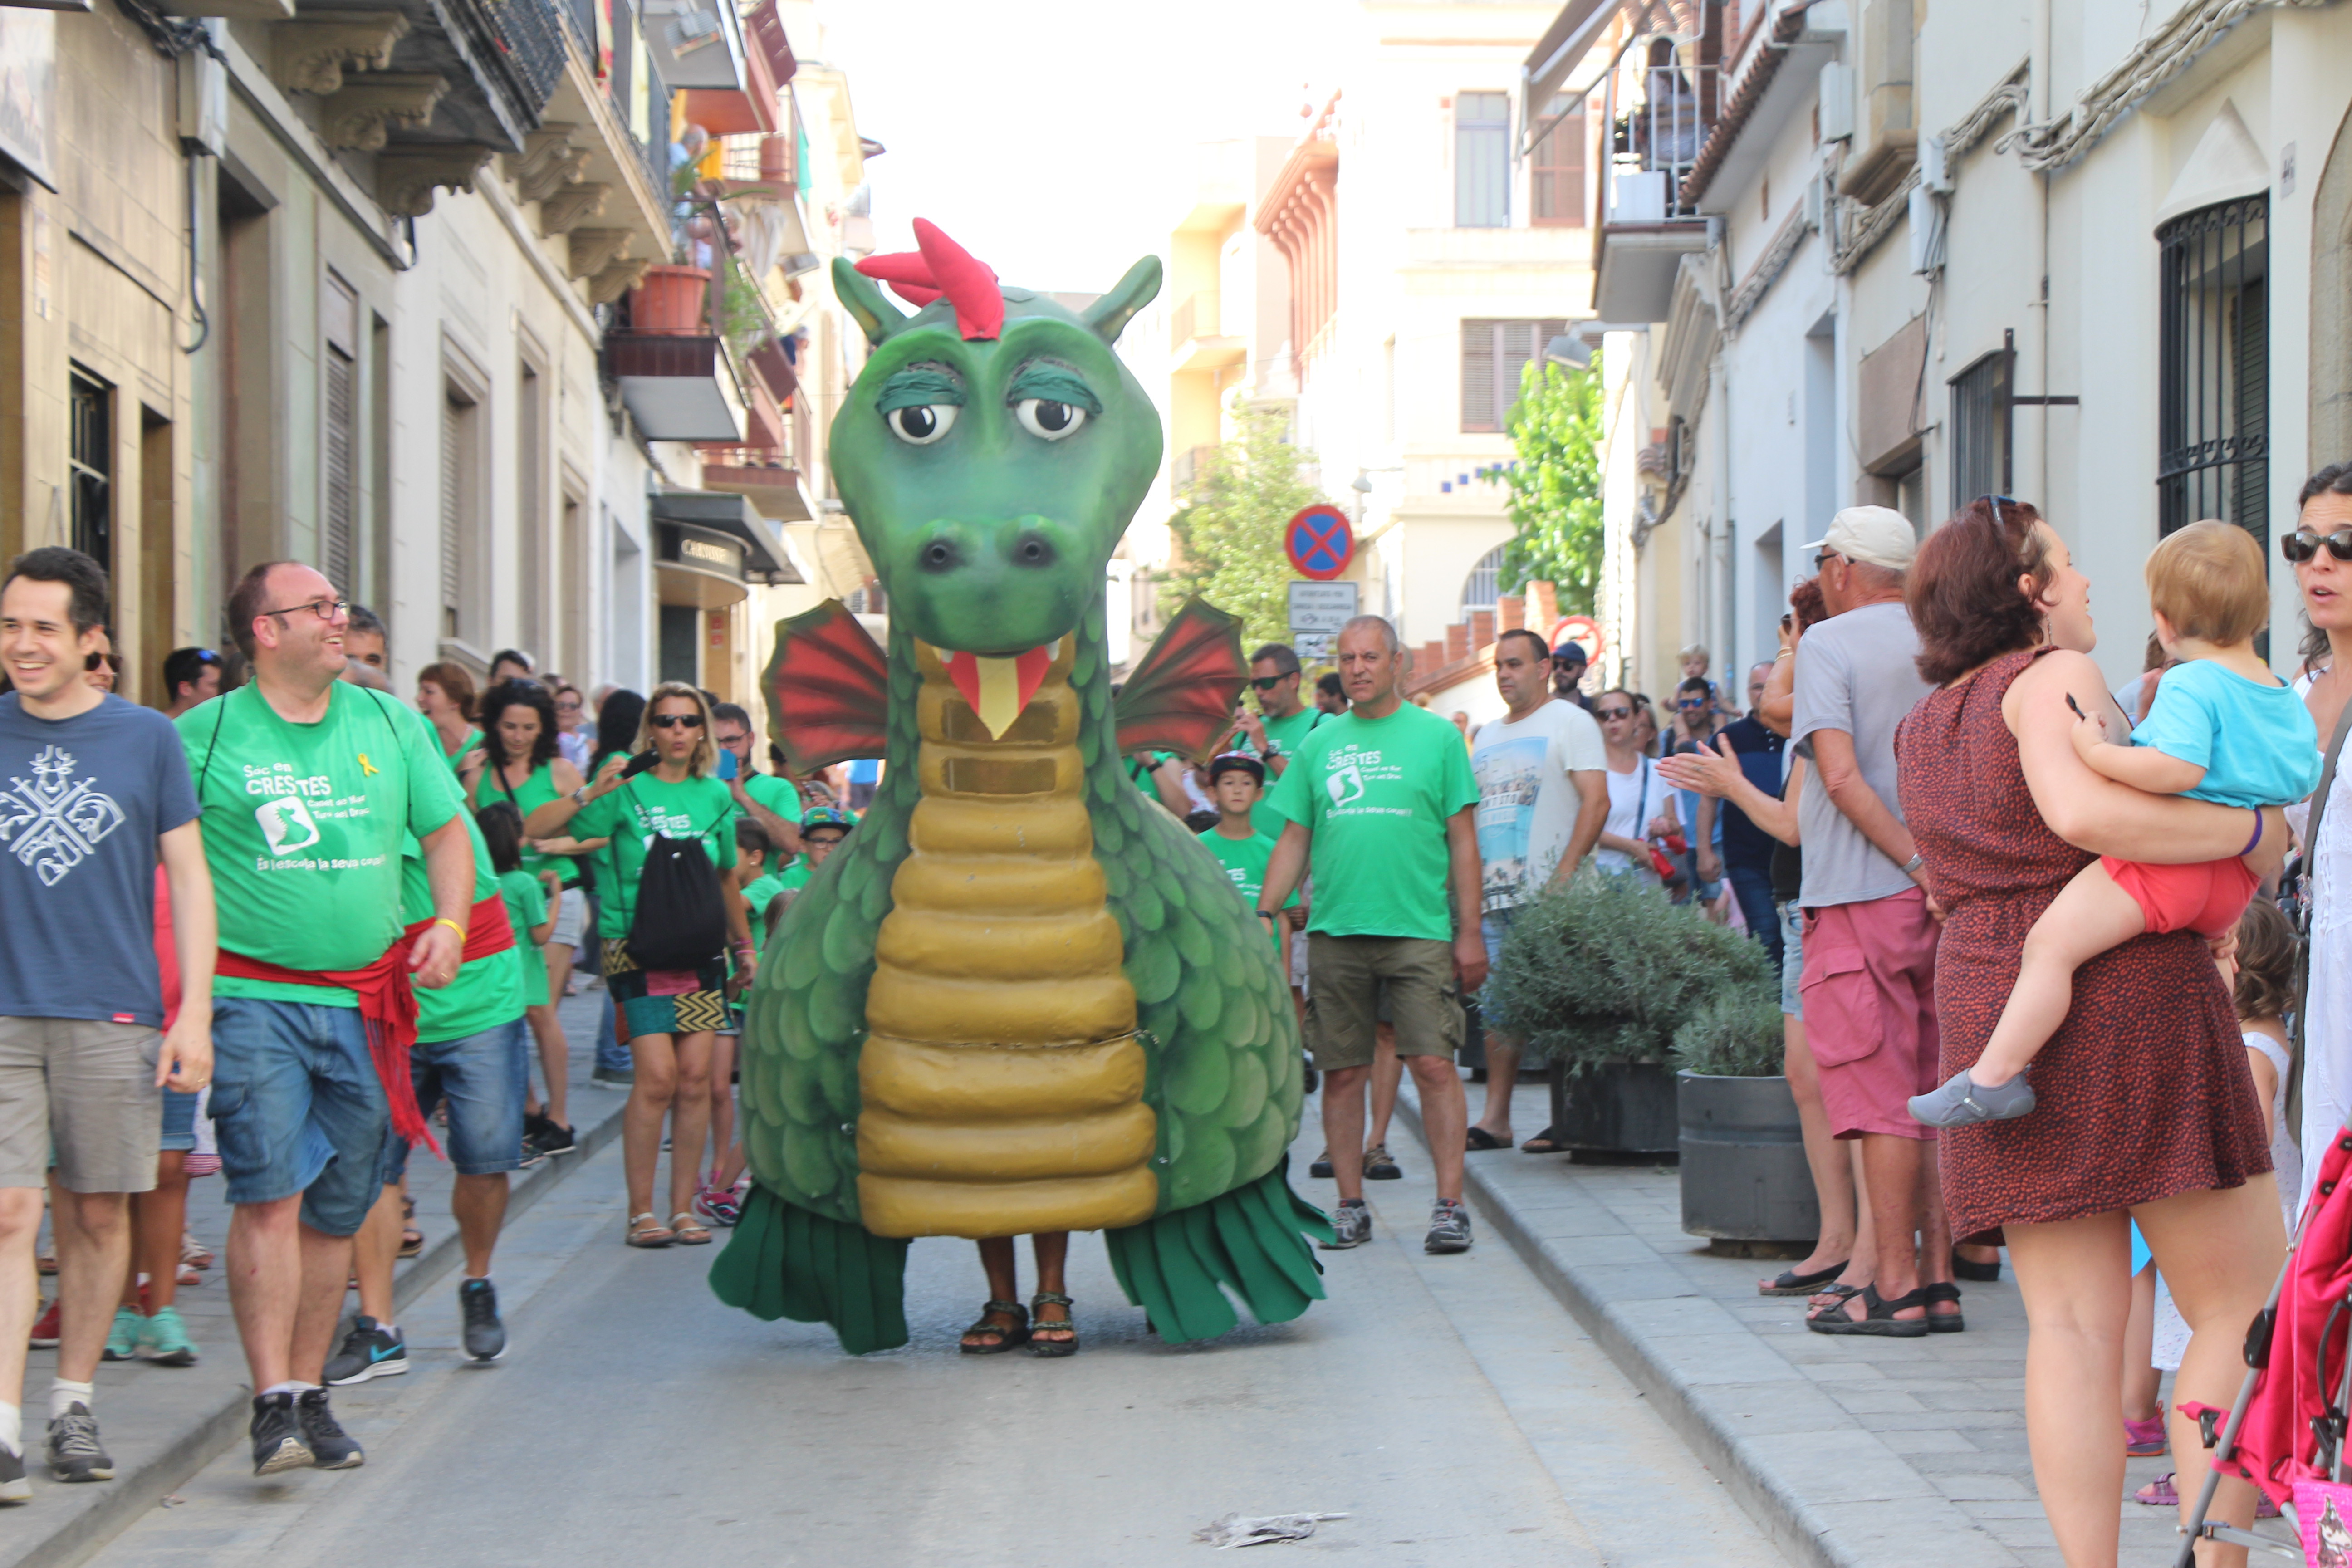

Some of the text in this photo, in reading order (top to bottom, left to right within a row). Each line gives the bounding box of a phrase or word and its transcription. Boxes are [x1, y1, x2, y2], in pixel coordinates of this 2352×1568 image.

[1325, 750, 1382, 770] CRESTES
[243, 762, 293, 778] Sóc en
[245, 774, 332, 796] CRESTES
[318, 857, 330, 871] la
[331, 858, 360, 869] seva
